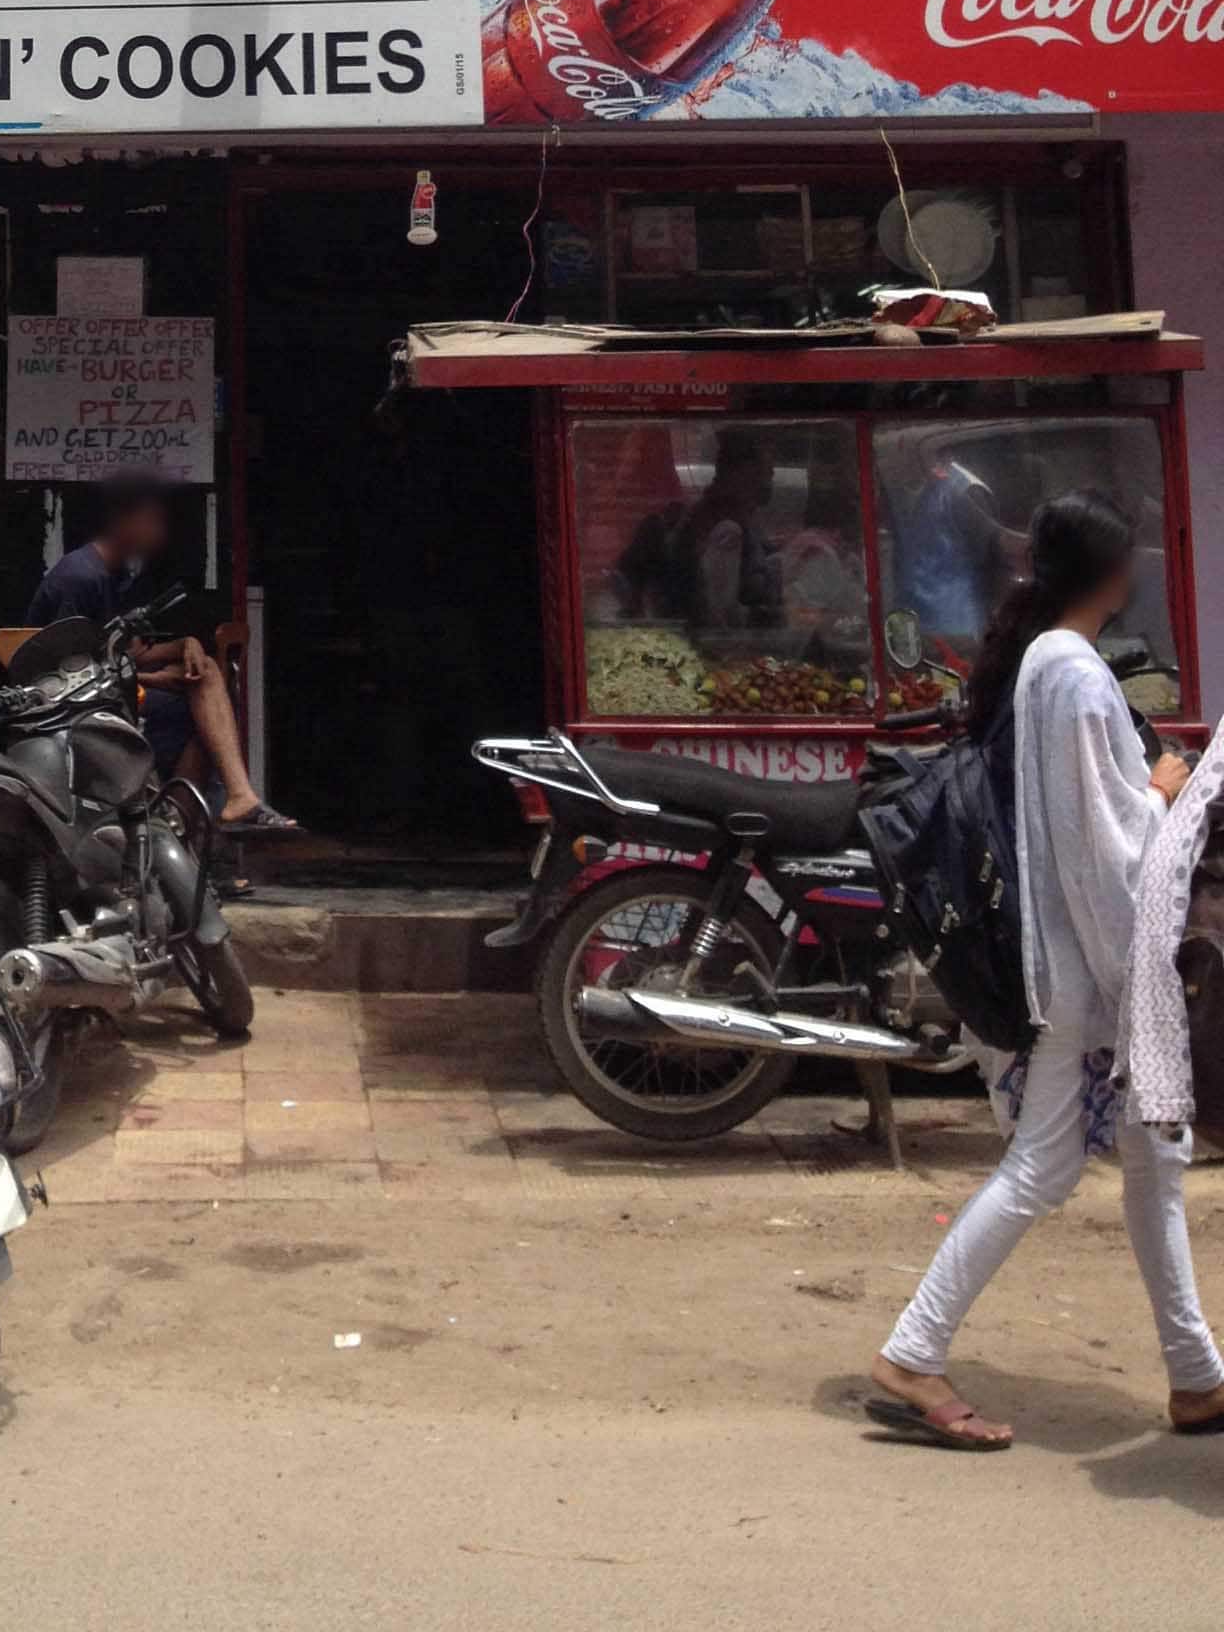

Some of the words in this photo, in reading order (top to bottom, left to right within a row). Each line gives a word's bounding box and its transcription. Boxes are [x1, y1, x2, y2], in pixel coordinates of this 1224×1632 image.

[59, 28, 426, 99] COOKIES
[19, 319, 80, 337] OFFER
[85, 318, 149, 337] OFFER
[32, 336, 135, 356] SPECIAL
[142, 338, 207, 356] OFFER
[81, 358, 195, 383] BURGER
[111, 384, 139, 400] OR
[79, 399, 197, 426] PIZZA
[14, 427, 58, 448] AND
[65, 427, 117, 448] GET
